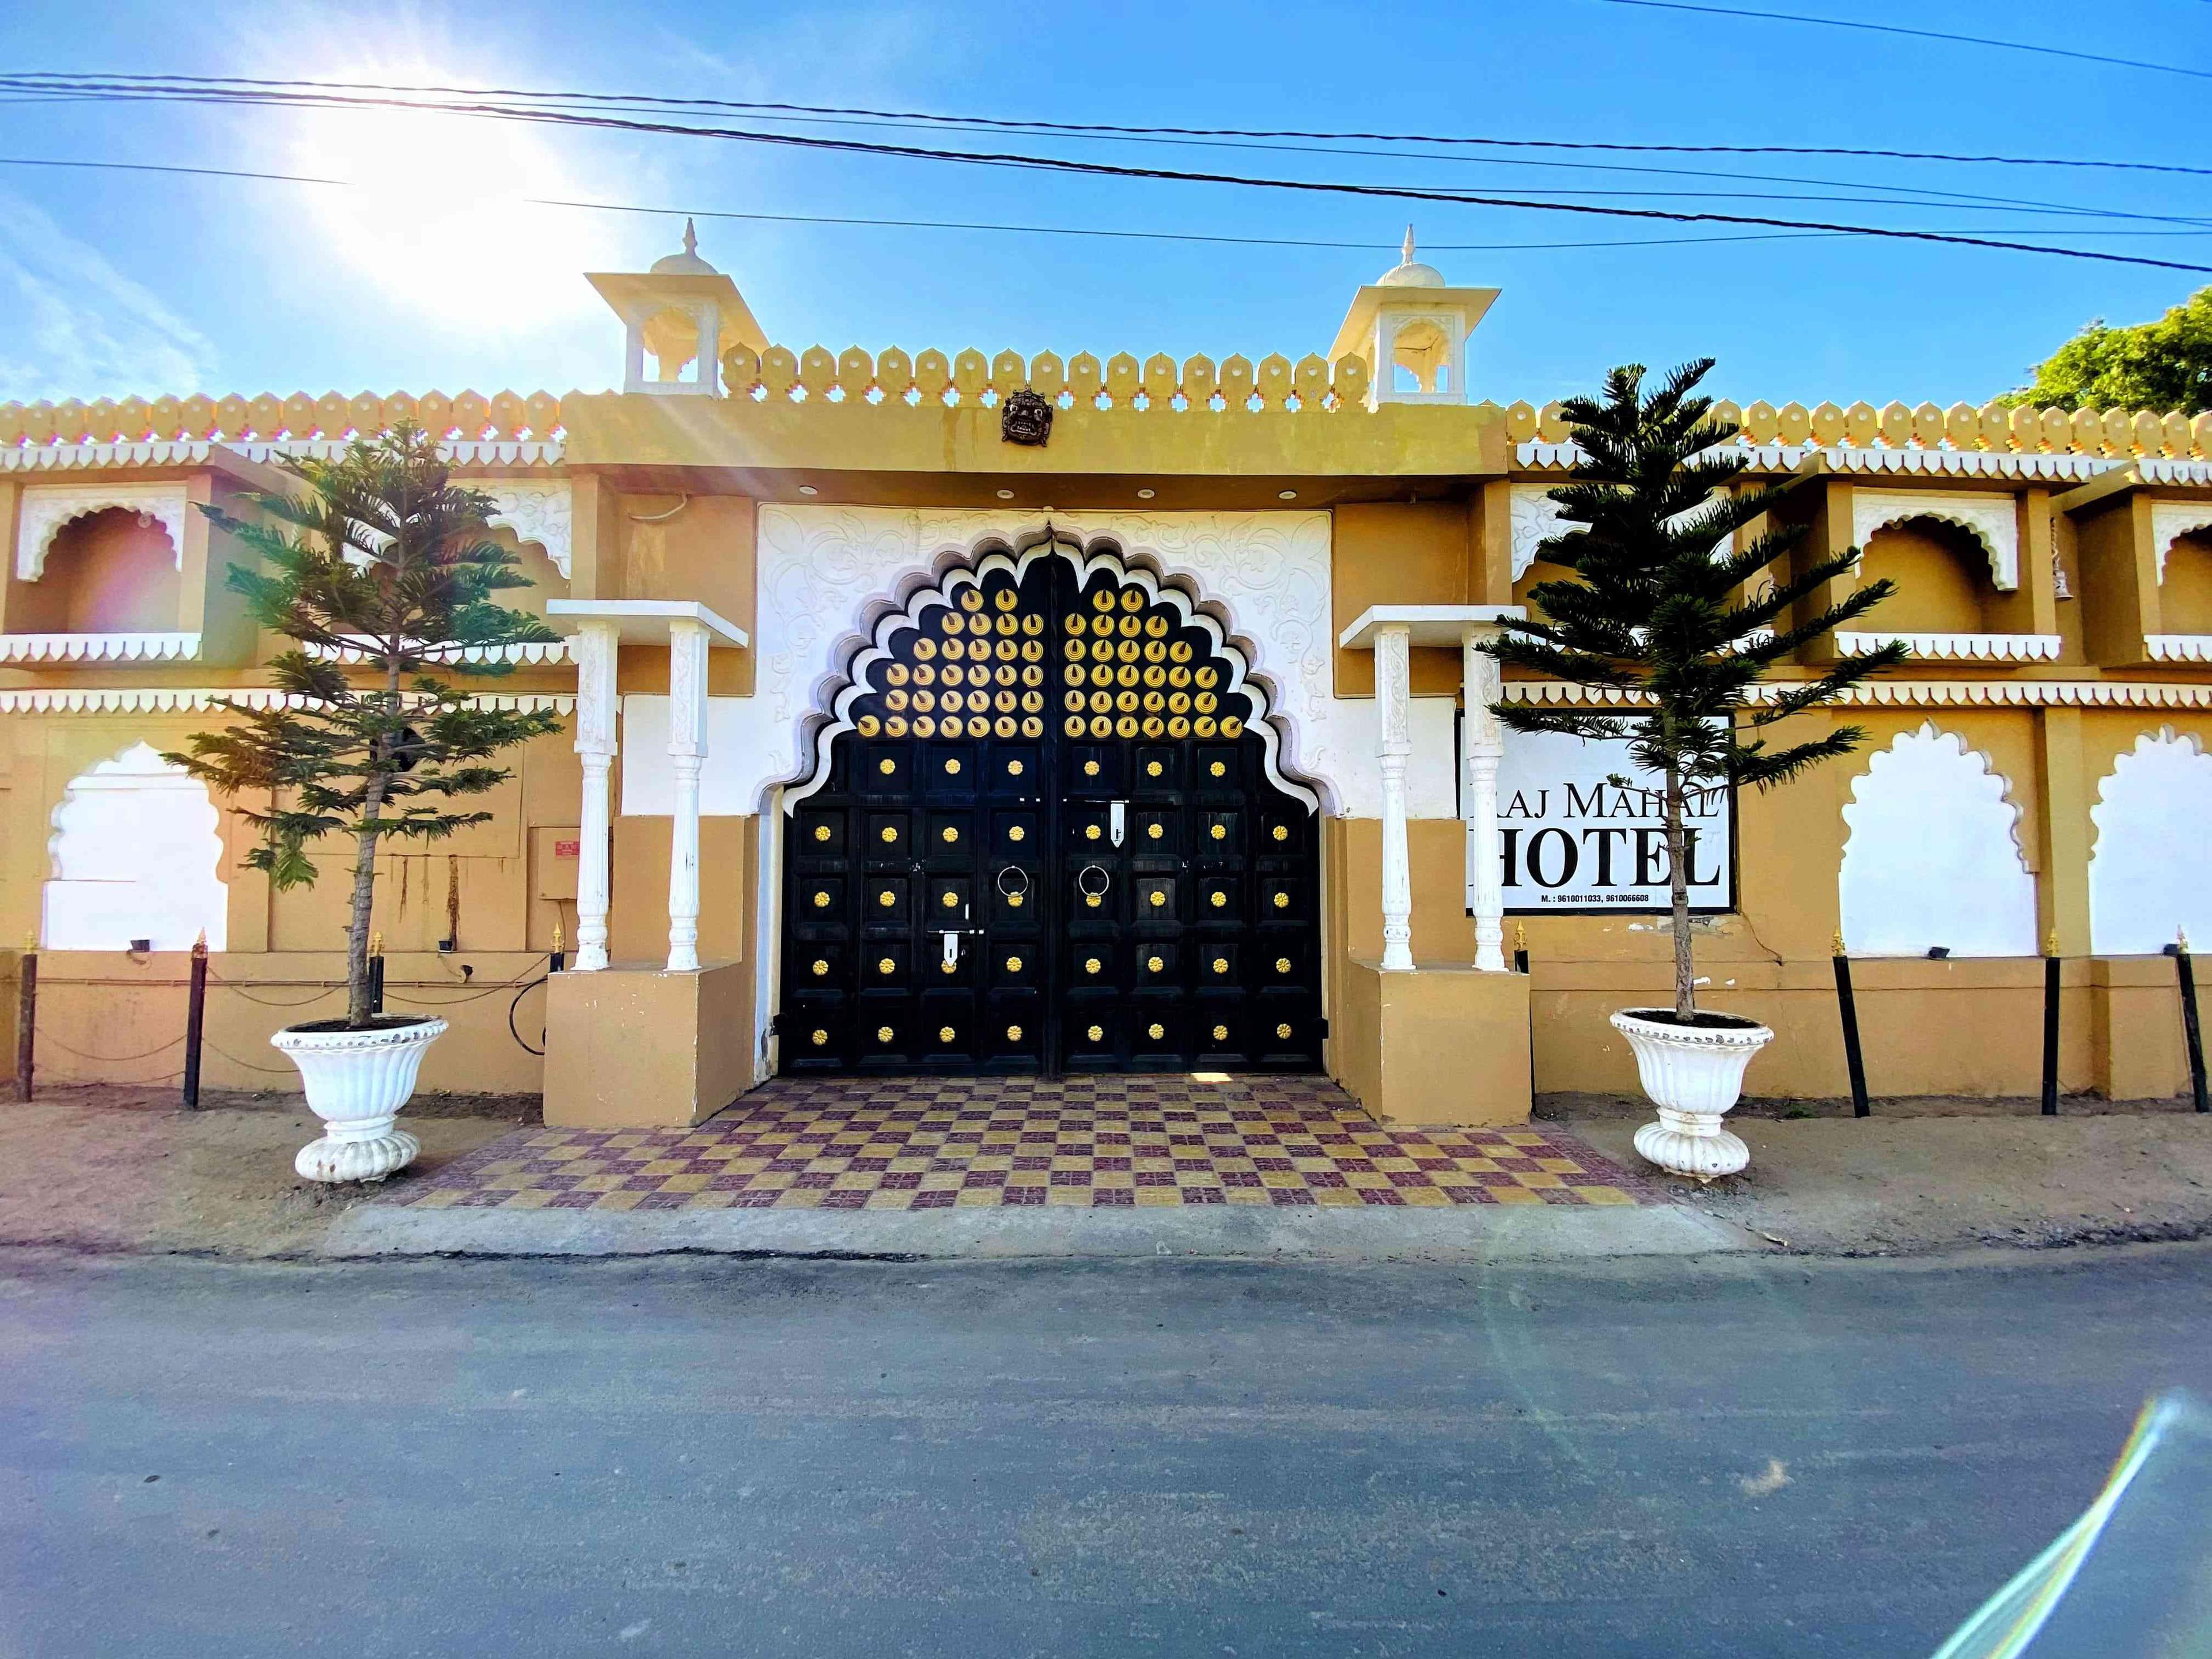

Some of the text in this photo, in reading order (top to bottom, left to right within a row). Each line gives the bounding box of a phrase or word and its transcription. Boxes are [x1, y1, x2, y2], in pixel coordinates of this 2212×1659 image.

[1469, 783, 1550, 819] AJ
[1558, 895, 1604, 903] 9610011033,
[1606, 894, 1649, 902] 9610066608
